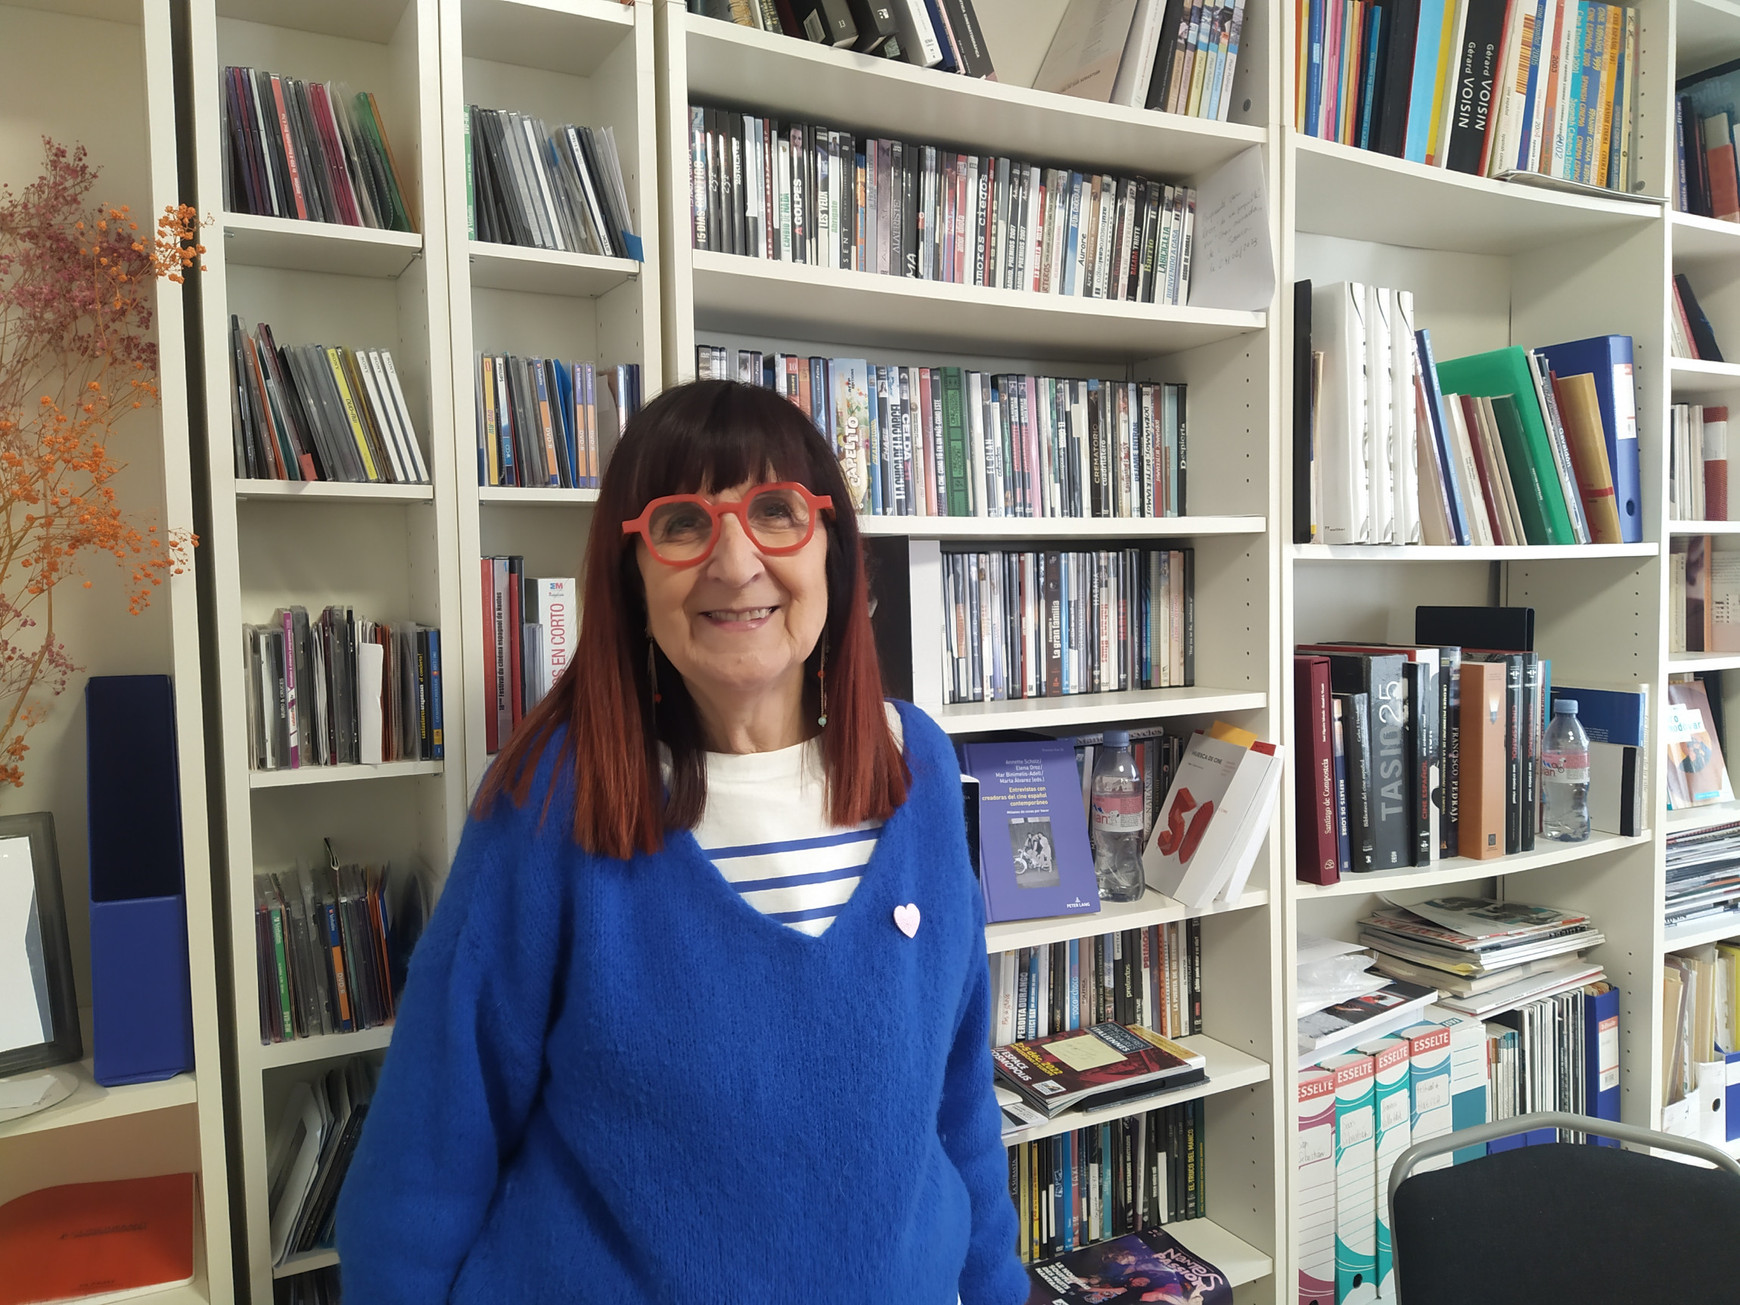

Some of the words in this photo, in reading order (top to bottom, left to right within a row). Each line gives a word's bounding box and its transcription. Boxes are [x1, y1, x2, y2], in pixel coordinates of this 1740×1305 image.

[838, 18, 848, 29] 13
[1577, 9, 1585, 26] Cine
[1597, 6, 1606, 23] CINE
[1532, 19, 1543, 46] español
[1573, 27, 1583, 57] Español
[1594, 24, 1605, 54] ESPAÑOL
[1463, 41, 1476, 74] Gérard
[1482, 43, 1495, 76] Gérard
[1530, 47, 1540, 66] 2005
[1550, 54, 1559, 73] 2003
[1571, 56, 1580, 74] 2001
[1592, 55, 1602, 72] 1999
[1457, 77, 1474, 129] VOISIN
[1473, 79, 1492, 131] VOISIN
[1568, 97, 1578, 126] Spanish
[1604, 100, 1613, 124] SPANISH
[1587, 107, 1597, 135] SPANISH
[1565, 127, 1577, 156] Cinema
[1602, 124, 1610, 145] CINEMA
[1555, 135, 1567, 160] 2002
[1584, 135, 1595, 162] CINEMA
[792, 179, 803, 226] GOLPES
[978, 173, 988, 227] ciegos
[794, 226, 803, 236] A
[819, 212, 829, 228] LES
[892, 199, 901, 254] ALATRISTE
[1077, 233, 1087, 267] Aurore
[1132, 225, 1142, 250] TRISTE
[1170, 229, 1179, 250] CASA
[975, 236, 985, 286] amores
[1143, 238, 1155, 273] Barrio
[331, 352, 339, 370] SONY
[387, 357, 395, 375] SONY
[545, 427, 553, 449] DVD-R
[902, 413, 912, 461] CELDA
[1179, 423, 1187, 470] Despierta
[1558, 427, 1572, 469] Gavaldón
[985, 438, 994, 462] CLAN
[1092, 422, 1101, 484] CREMATORIO
[495, 591, 503, 612] Nantes
[496, 611, 503, 620] de
[549, 603, 565, 646] CORTO
[1051, 600, 1061, 630] familia
[496, 619, 504, 647] espagnol
[1052, 630, 1062, 649] gran
[496, 646, 504, 667] cinéma
[550, 647, 566, 666] EN
[496, 667, 504, 676] du
[497, 675, 505, 698] Festival
[1451, 726, 1460, 777] FRANCISCO
[1321, 757, 1332, 796] Compostela
[1360, 758, 1368, 779] español
[1420, 759, 1428, 798] ESPAÑOL
[1028, 792, 1048, 800] español
[1323, 796, 1332, 806] de
[1449, 779, 1459, 824] PEDRAJA
[1322, 807, 1334, 835] Santiago
[1340, 806, 1346, 816] DE
[1362, 800, 1370, 828] Biblioteca
[1141, 929, 1150, 969] PRIMOS
[336, 972, 345, 994] DVD-R
[1017, 1008, 1028, 1040] PERDITA
[1090, 1026, 1131, 1052] ITALIENNES
[1414, 1031, 1450, 1052] ESSELTE
[1002, 1051, 1030, 1070] ESPACE
[1041, 1061, 1065, 1076] 2022
[1379, 1045, 1408, 1070] ESSELTE
[1337, 1061, 1374, 1084] ESSELTE
[1187, 1129, 1195, 1151] MANCO
[1187, 1151, 1195, 1163] DEL
[1188, 1184, 1195, 1192] EL
[1055, 1262, 1065, 1270] LE
[1152, 1252, 1216, 1292] PASSION
